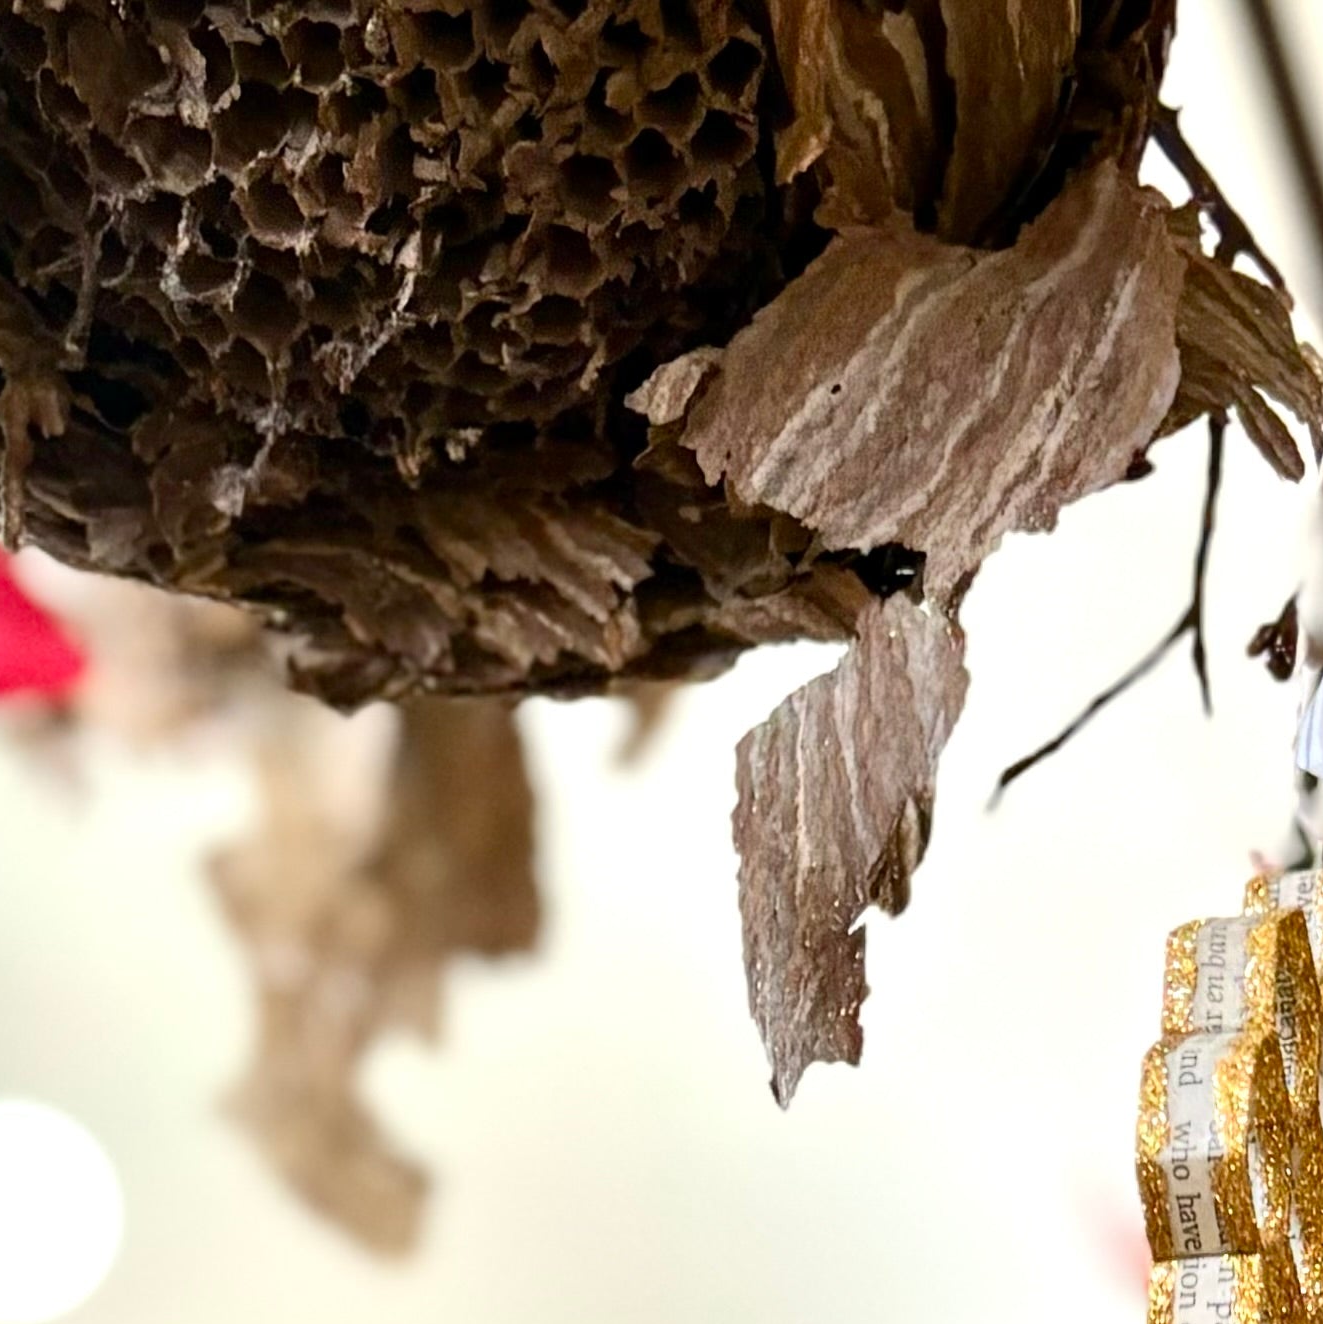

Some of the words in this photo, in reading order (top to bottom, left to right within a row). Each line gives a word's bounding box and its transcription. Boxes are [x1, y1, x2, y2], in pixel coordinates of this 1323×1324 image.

[1204, 976, 1225, 1004] en
[1171, 1120, 1198, 1181] who
[1175, 1192, 1203, 1251] have
